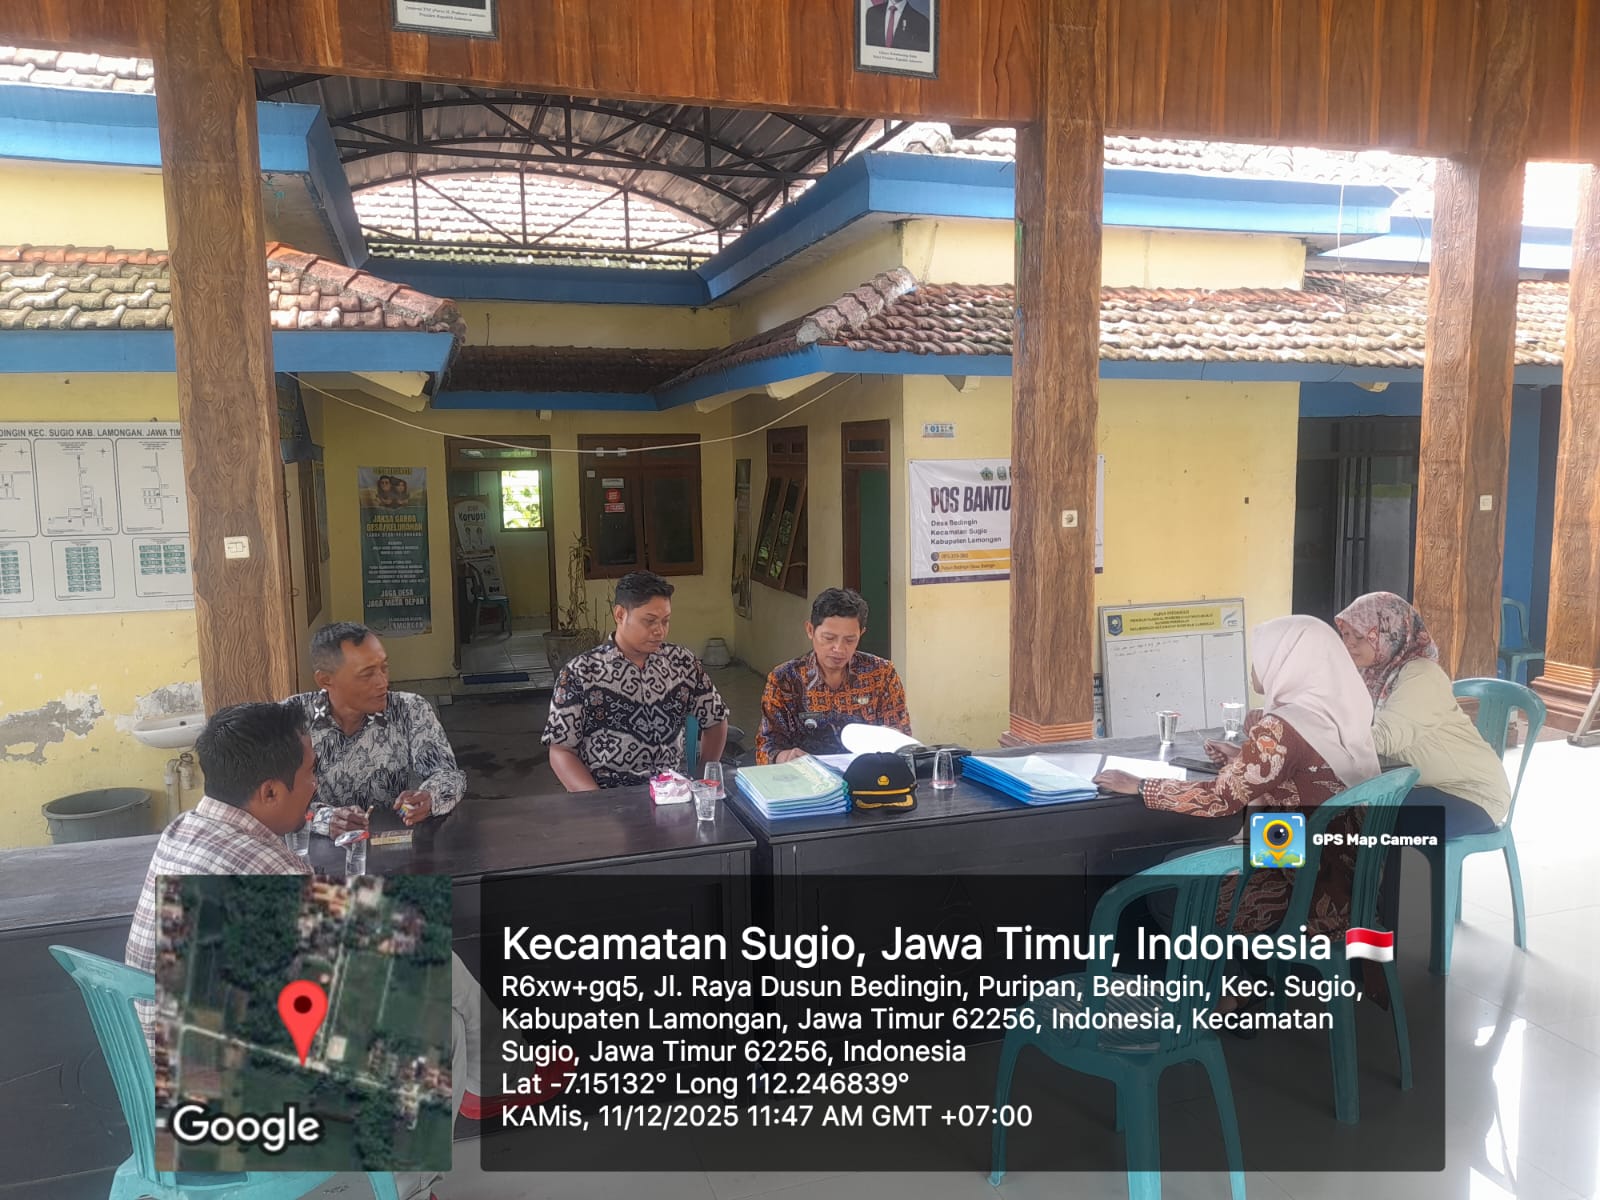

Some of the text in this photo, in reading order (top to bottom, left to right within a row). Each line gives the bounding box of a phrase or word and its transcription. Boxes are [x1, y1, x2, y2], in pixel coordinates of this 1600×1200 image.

[28, 428, 48, 437] KEC.
[49, 428, 75, 437] SUGIO
[76, 428, 95, 437] KAB.
[146, 428, 168, 437] JAWA
[930, 485, 1011, 514] POS BANTU
[458, 511, 486, 523] Korupsi
[949, 519, 978, 528] Bedingin
